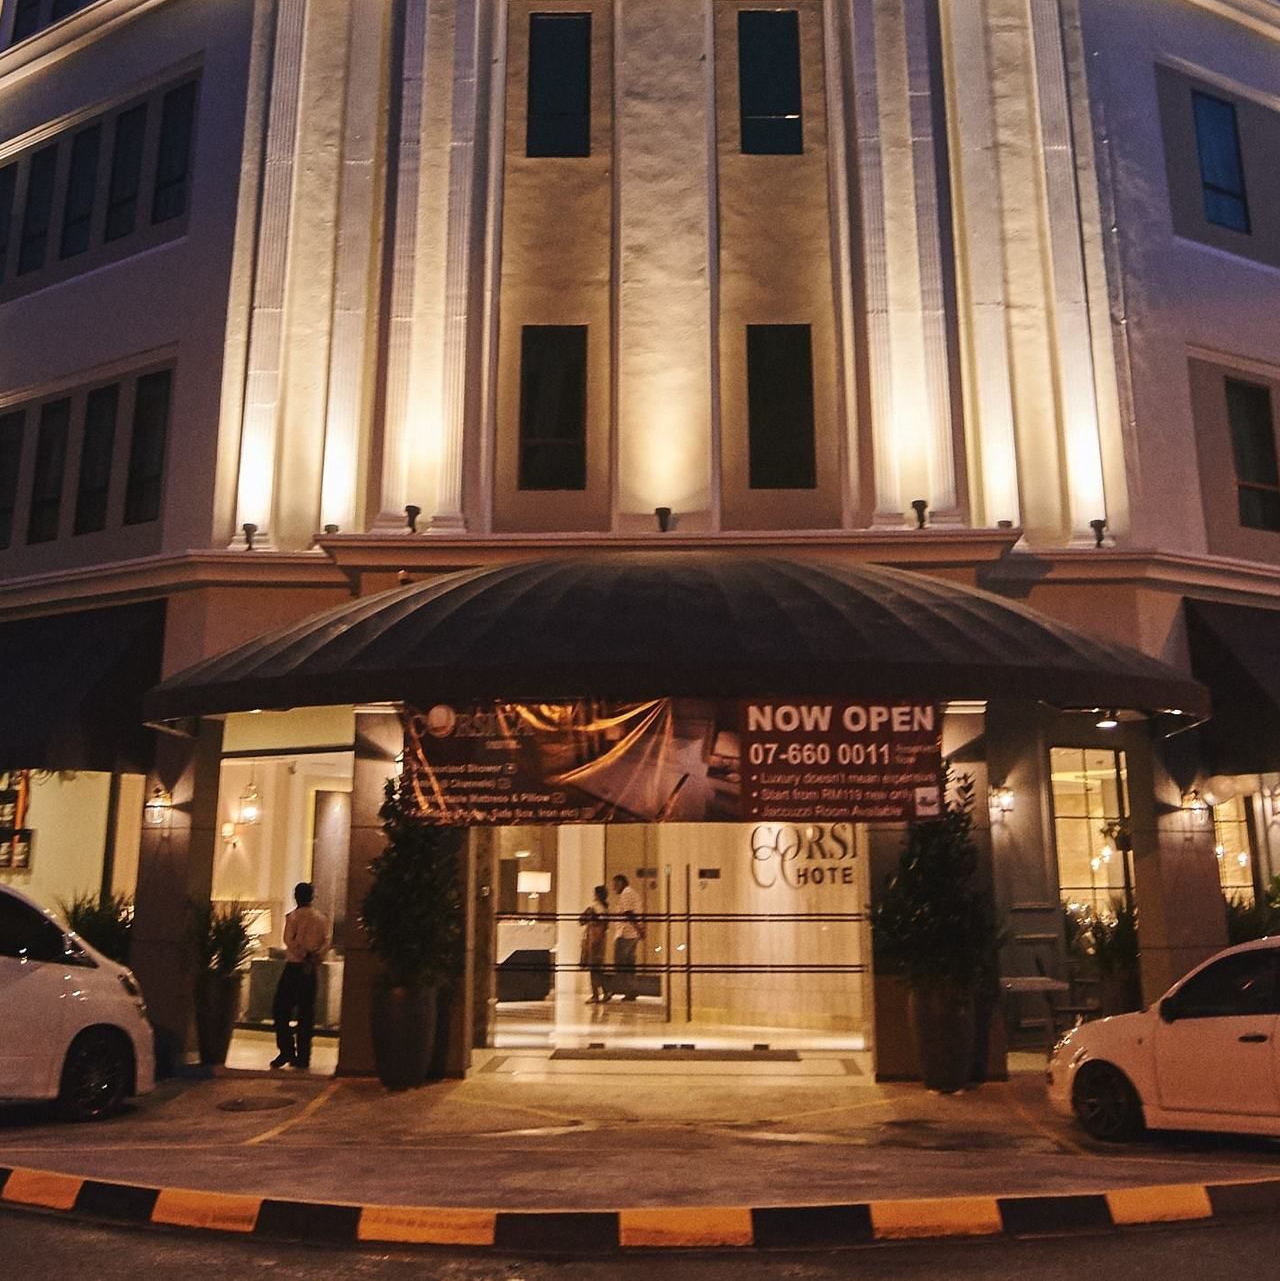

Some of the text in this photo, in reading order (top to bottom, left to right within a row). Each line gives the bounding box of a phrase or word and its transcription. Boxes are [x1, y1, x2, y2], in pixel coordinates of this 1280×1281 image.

[748, 705, 934, 732] NOW OPEN
[749, 742, 831, 765] 07-660
[837, 742, 890, 765] 0011
[760, 773, 802, 786] Luxury
[848, 775, 879, 784] mean
[519, 792, 551, 803] Pillow
[761, 789, 790, 801] Start
[792, 788, 819, 801] from
[815, 804, 850, 817] Room
[852, 804, 903, 817] Available
[796, 866, 854, 885] HOTE
